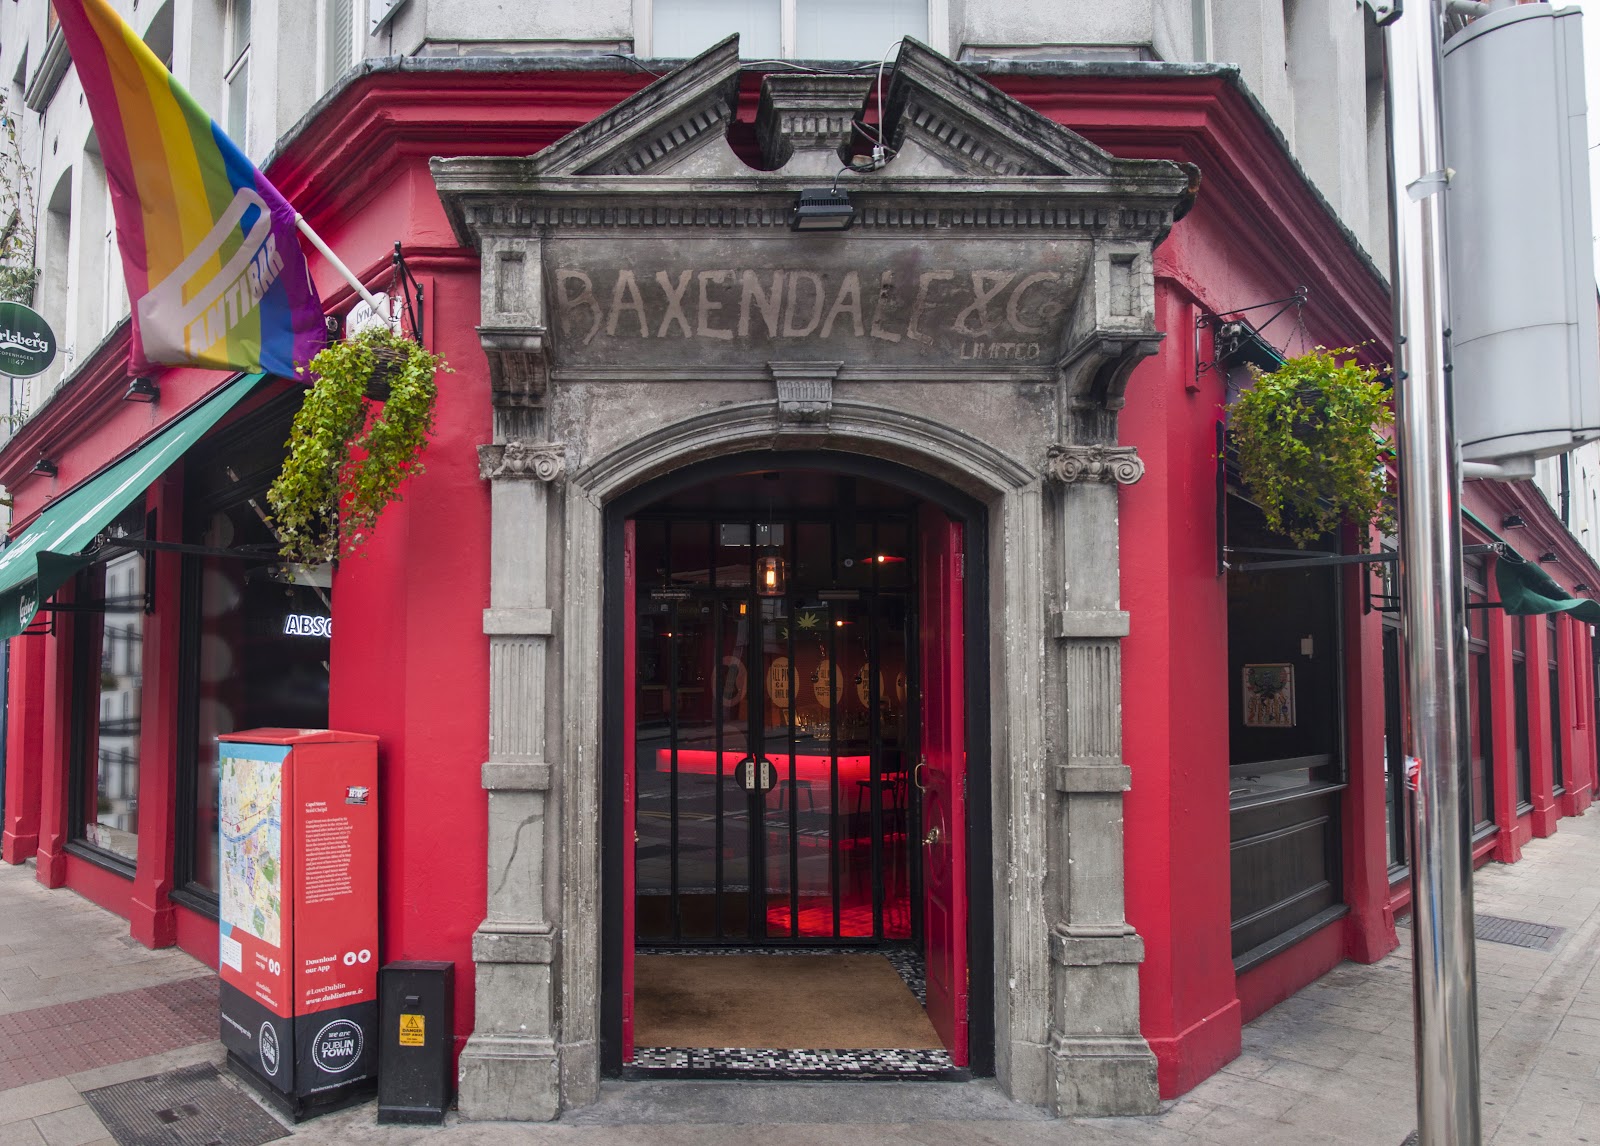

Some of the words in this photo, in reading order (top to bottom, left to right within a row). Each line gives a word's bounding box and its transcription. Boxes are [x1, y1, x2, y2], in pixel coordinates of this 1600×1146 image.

[554, 268, 954, 347] BAXENDALE
[0, 329, 49, 353] rlsberg
[305, 954, 337, 965] Download
[317, 964, 330, 973] App
[305, 982, 346, 996] #LoveDublin
[305, 987, 364, 1005] www.dublintown.ie
[321, 1039, 355, 1051] DUBLIN
[321, 1047, 354, 1059] TOWN
